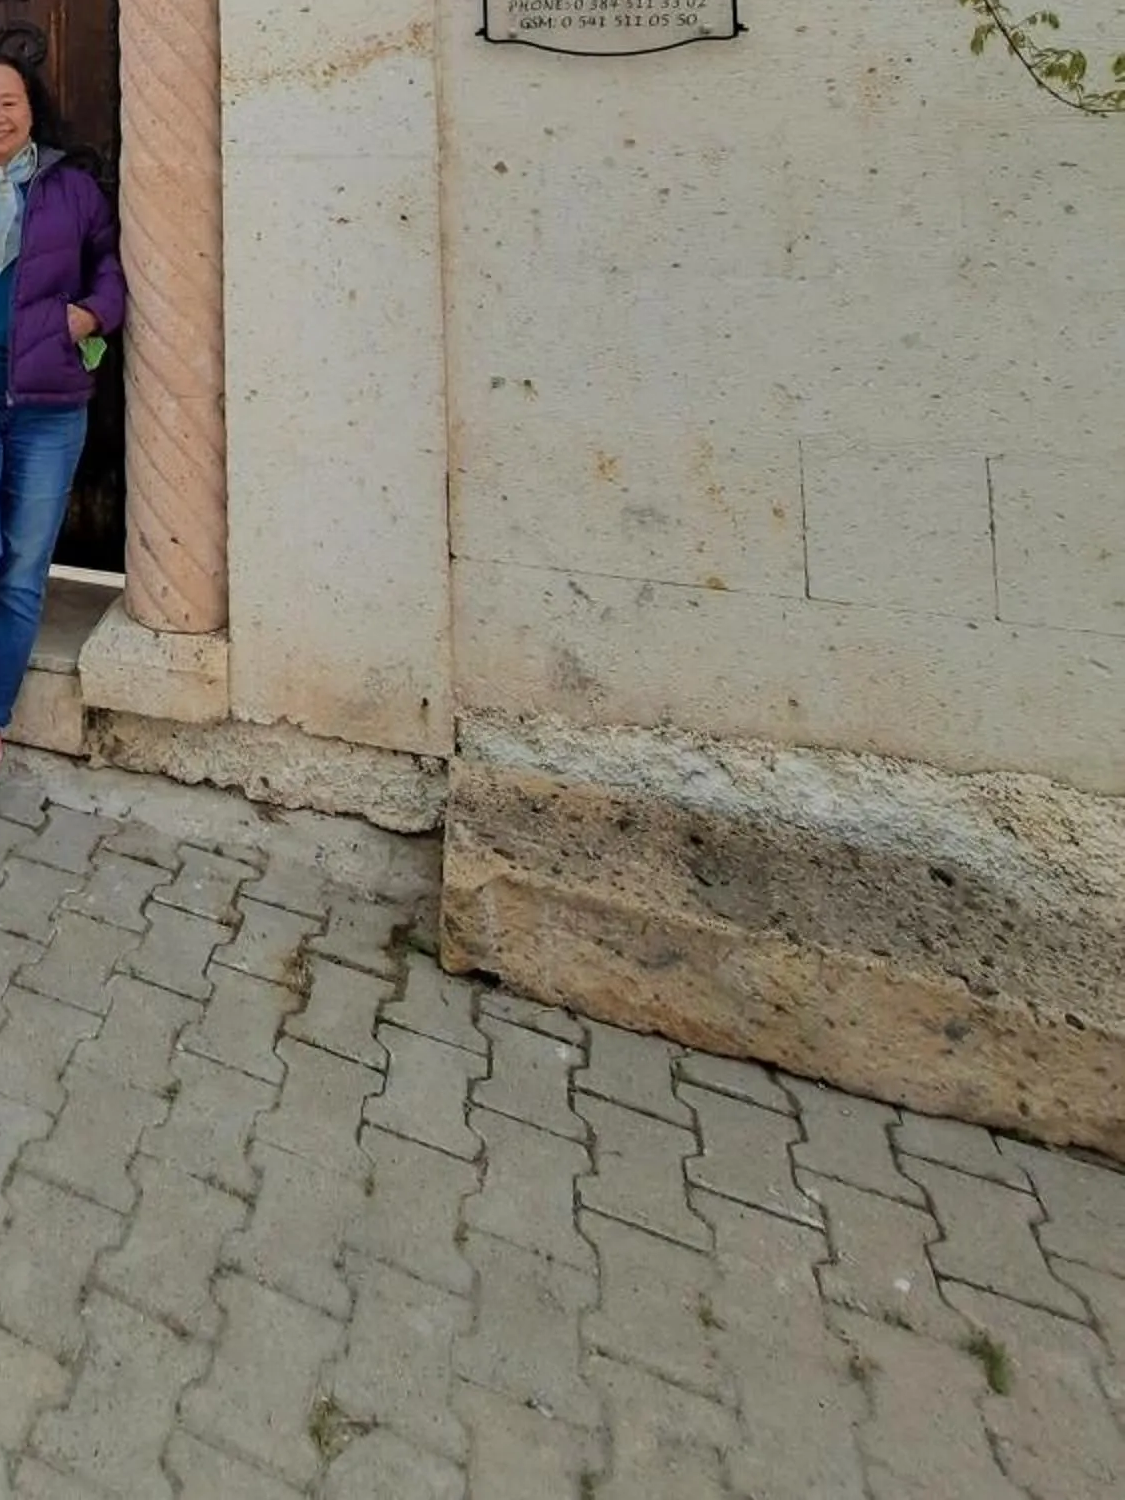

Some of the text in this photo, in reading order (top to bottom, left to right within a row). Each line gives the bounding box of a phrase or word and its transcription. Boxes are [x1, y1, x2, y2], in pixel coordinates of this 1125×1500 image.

[561, 16, 572, 27] 0
[579, 15, 605, 28] 541
[616, 14, 645, 27] 511
[648, 14, 669, 27] 05
[676, 13, 698, 26] 50
